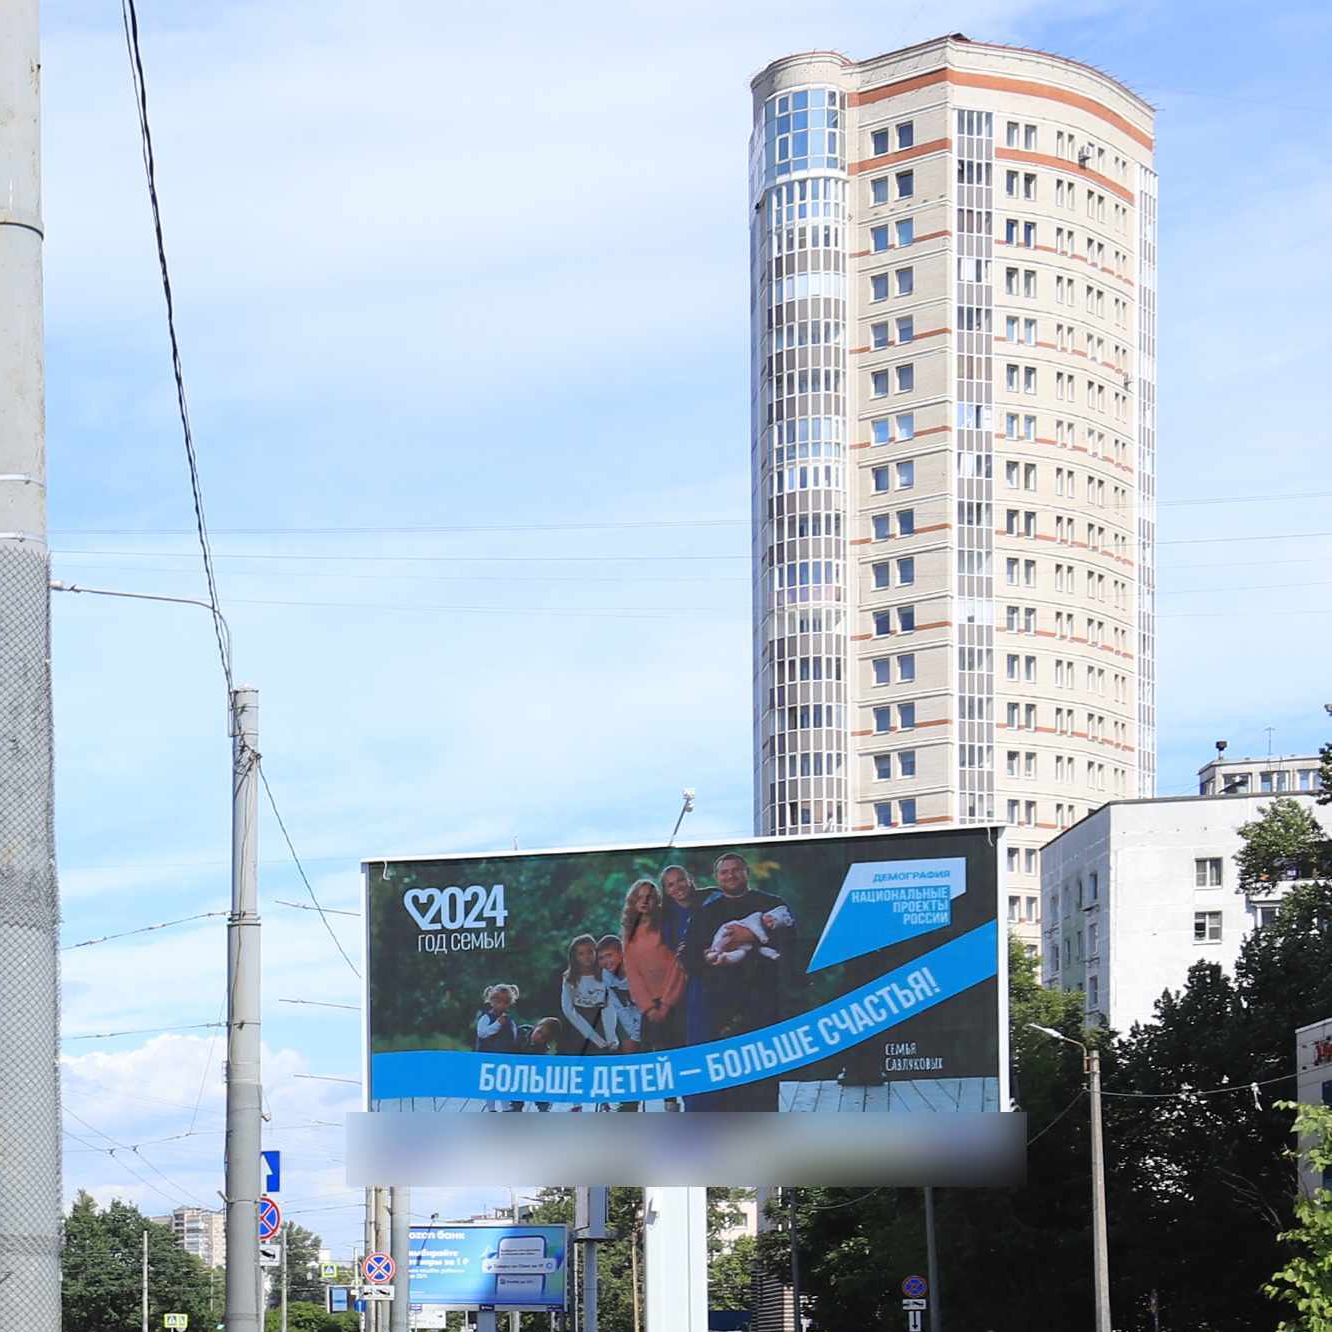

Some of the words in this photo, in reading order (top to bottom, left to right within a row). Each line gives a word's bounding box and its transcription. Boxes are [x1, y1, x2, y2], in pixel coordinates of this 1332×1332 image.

[872, 869, 952, 884] ДЕМОГРАФИЯ
[851, 886, 949, 904] НАЦИОНАЛЬНЫЕ
[404, 884, 509, 930] 2024
[892, 900, 949, 913] ПРОЕКТЫ
[902, 911, 949, 925] РОССИИ
[478, 1063, 584, 1095] БОЛЬШЕ
[590, 1056, 675, 1098] ДЕТЕЙ
[705, 1024, 820, 1083] БОЛЬШЕ
[817, 967, 942, 1046] СЧАСТЬЯ!
[885, 1042, 917, 1056] СЕМЬЯ
